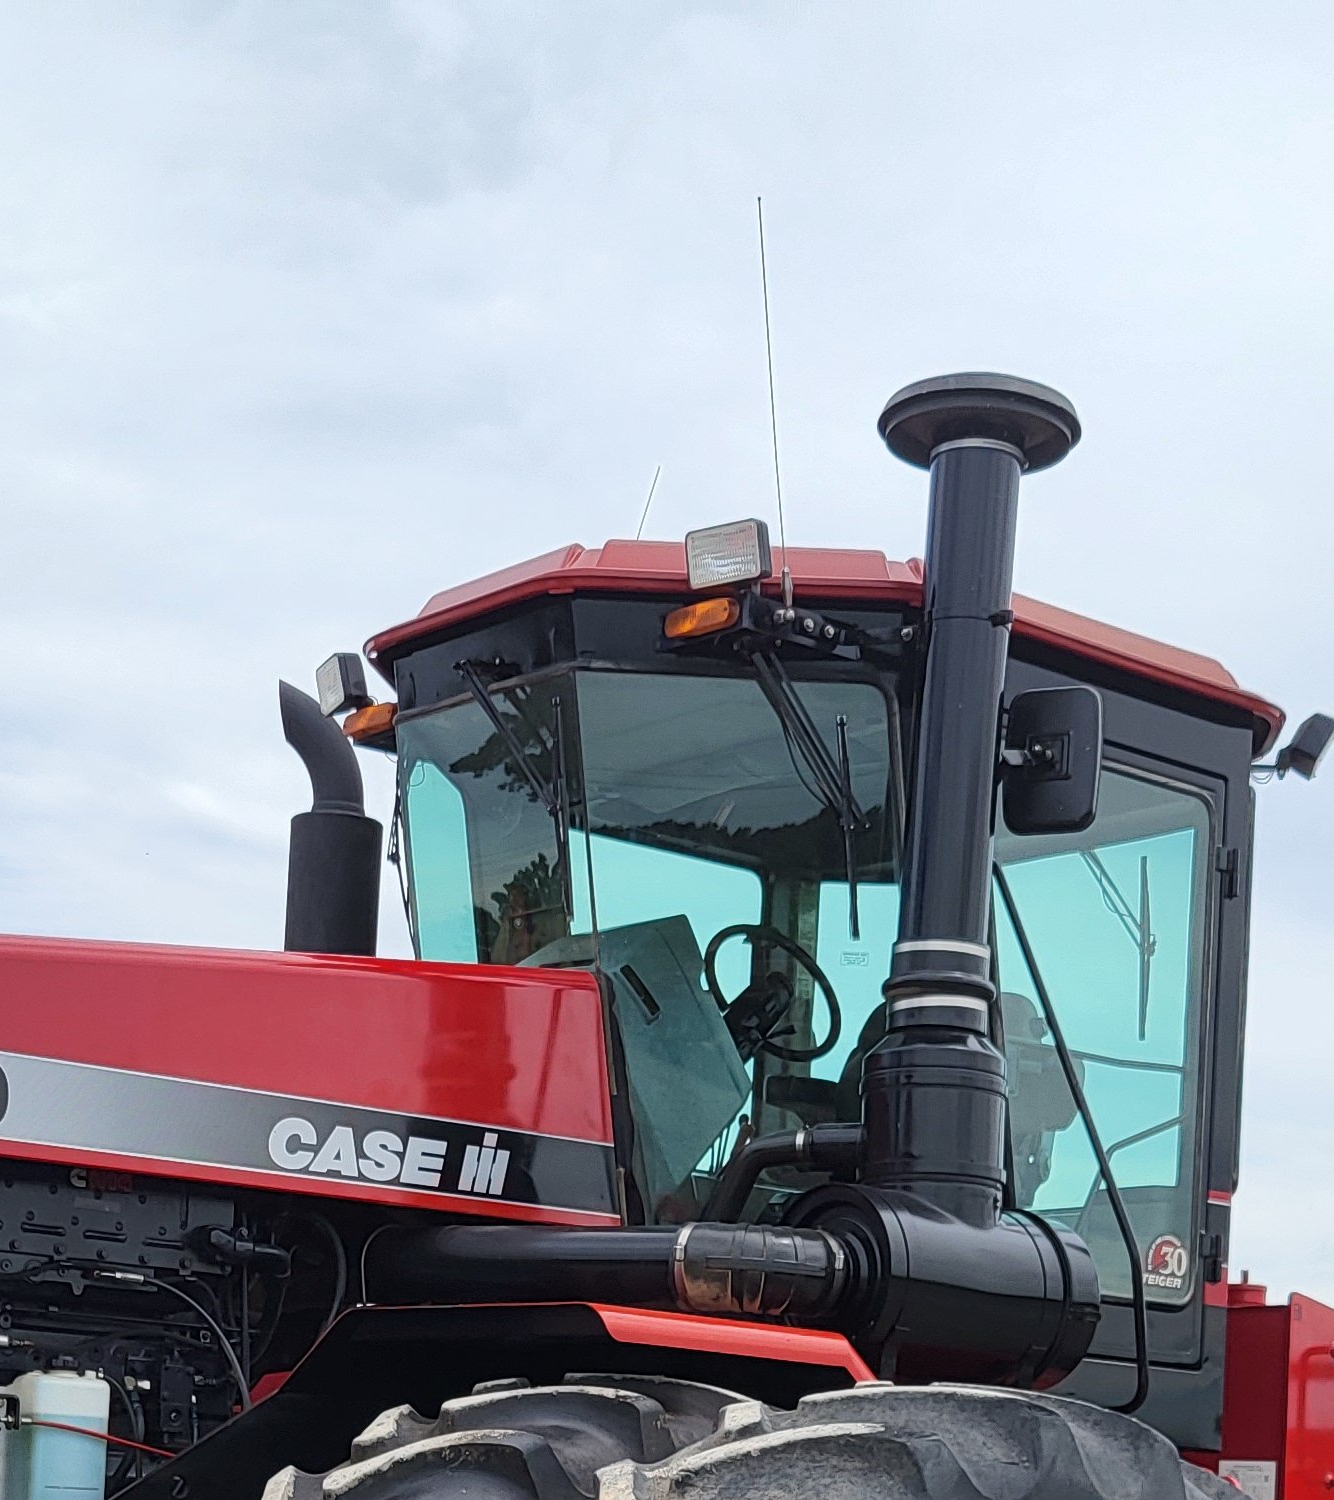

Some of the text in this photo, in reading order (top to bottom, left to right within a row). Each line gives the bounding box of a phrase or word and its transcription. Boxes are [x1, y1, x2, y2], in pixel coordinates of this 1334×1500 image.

[268, 1117, 449, 1188] CASE
[1160, 1246, 1187, 1276] 30
[1142, 1273, 1181, 1288] TEIGER
